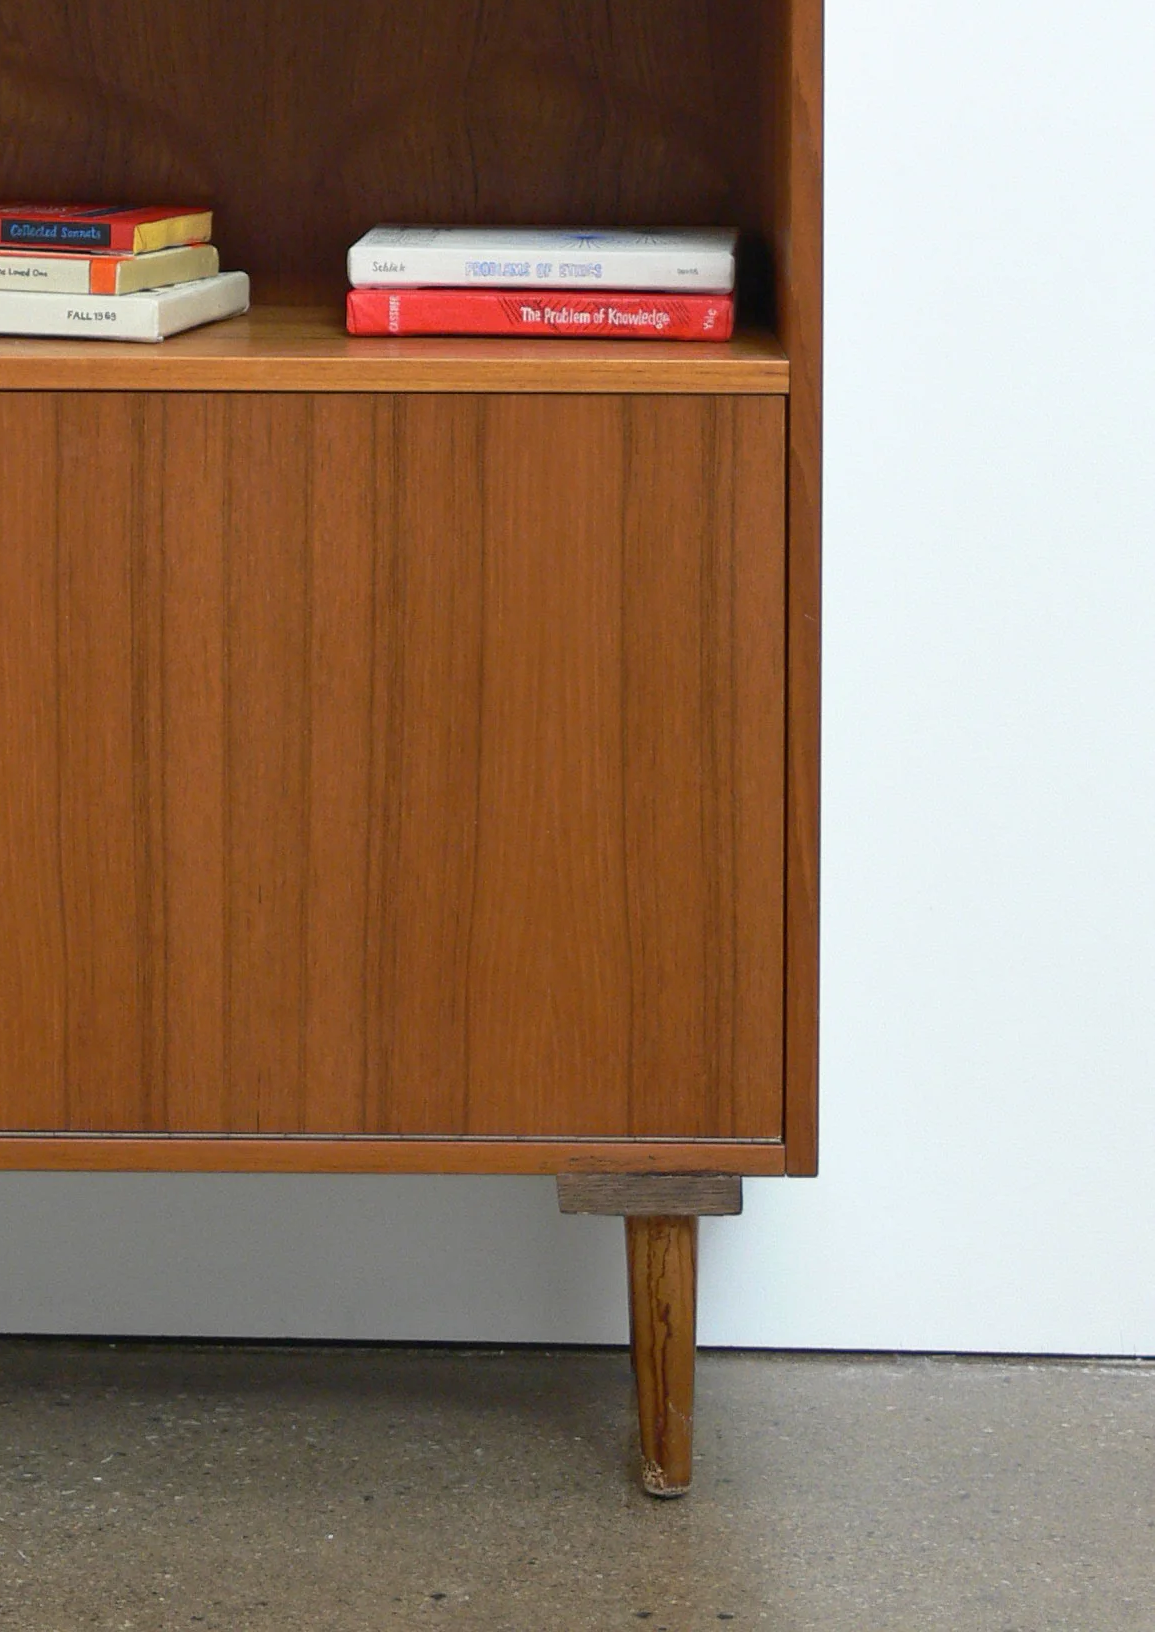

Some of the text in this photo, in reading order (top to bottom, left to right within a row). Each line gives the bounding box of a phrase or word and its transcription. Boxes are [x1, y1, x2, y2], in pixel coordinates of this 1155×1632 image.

[9, 223, 102, 241] Collected Sonnets
[67, 310, 92, 322] FALL
[520, 306, 671, 330] The Problem of Knowledge
